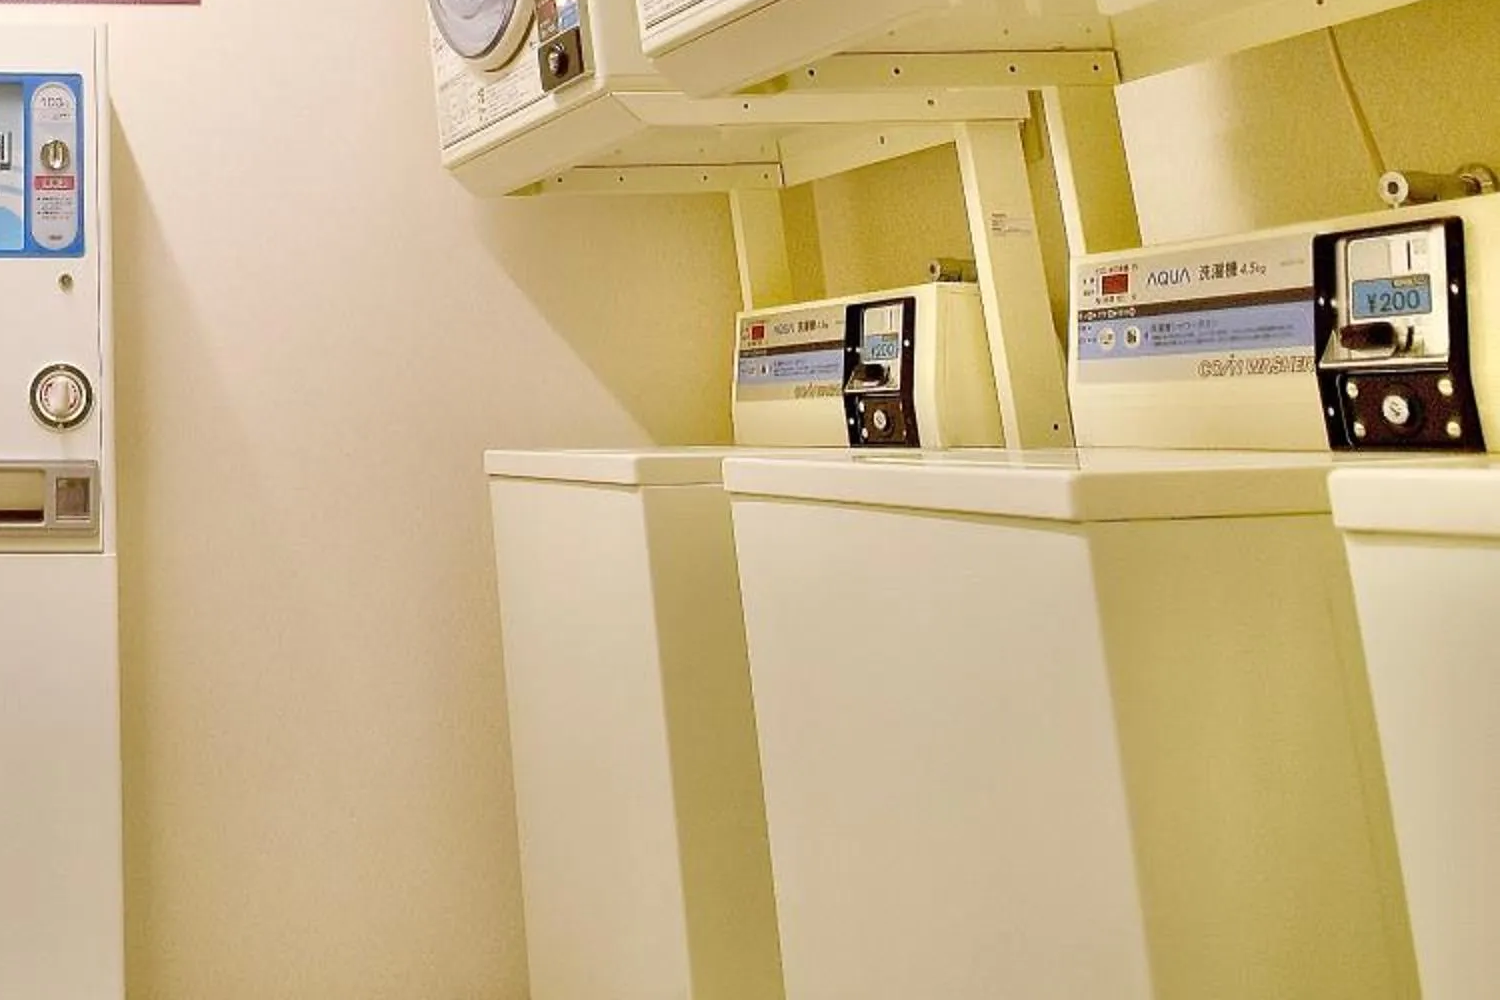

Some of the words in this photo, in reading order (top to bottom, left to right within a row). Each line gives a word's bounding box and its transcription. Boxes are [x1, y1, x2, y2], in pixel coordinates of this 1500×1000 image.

[1146, 268, 1191, 288] AQUA
[1198, 261, 1238, 281] 洗濯機
[1366, 289, 1421, 313] ¥200
